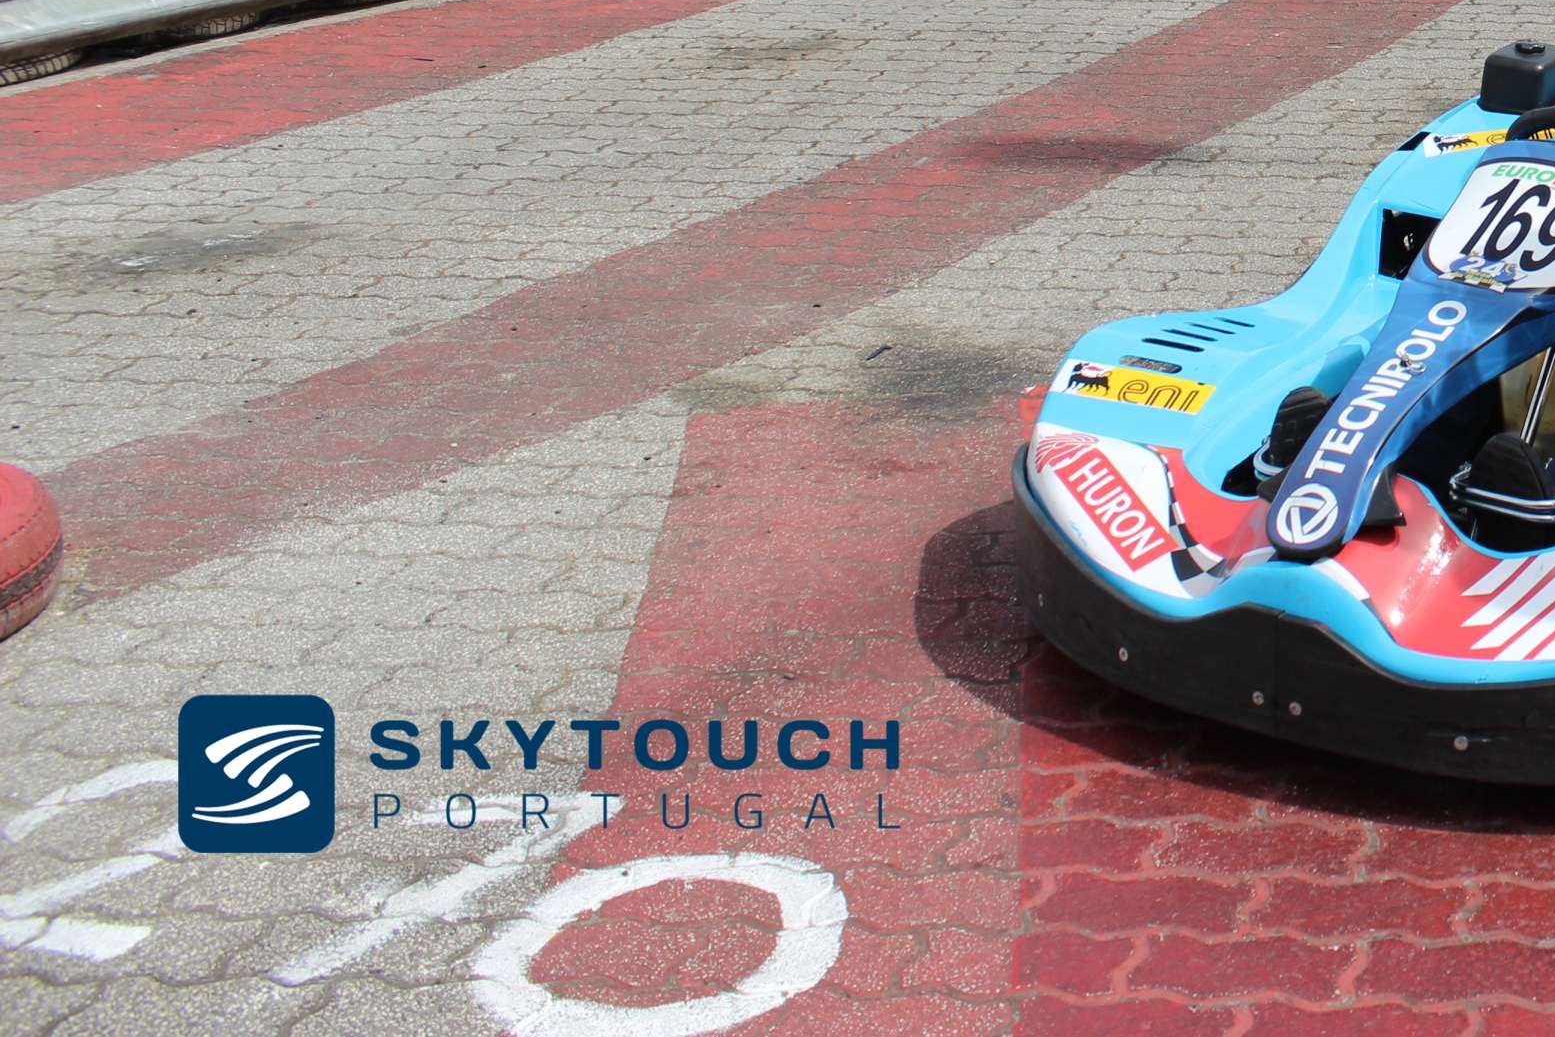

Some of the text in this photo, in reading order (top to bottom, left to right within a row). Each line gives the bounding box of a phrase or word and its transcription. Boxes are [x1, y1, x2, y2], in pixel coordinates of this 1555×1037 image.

[1117, 379, 1205, 412] eni
[1304, 300, 1468, 479] TECNIROLO
[1068, 457, 1166, 560] HURON
